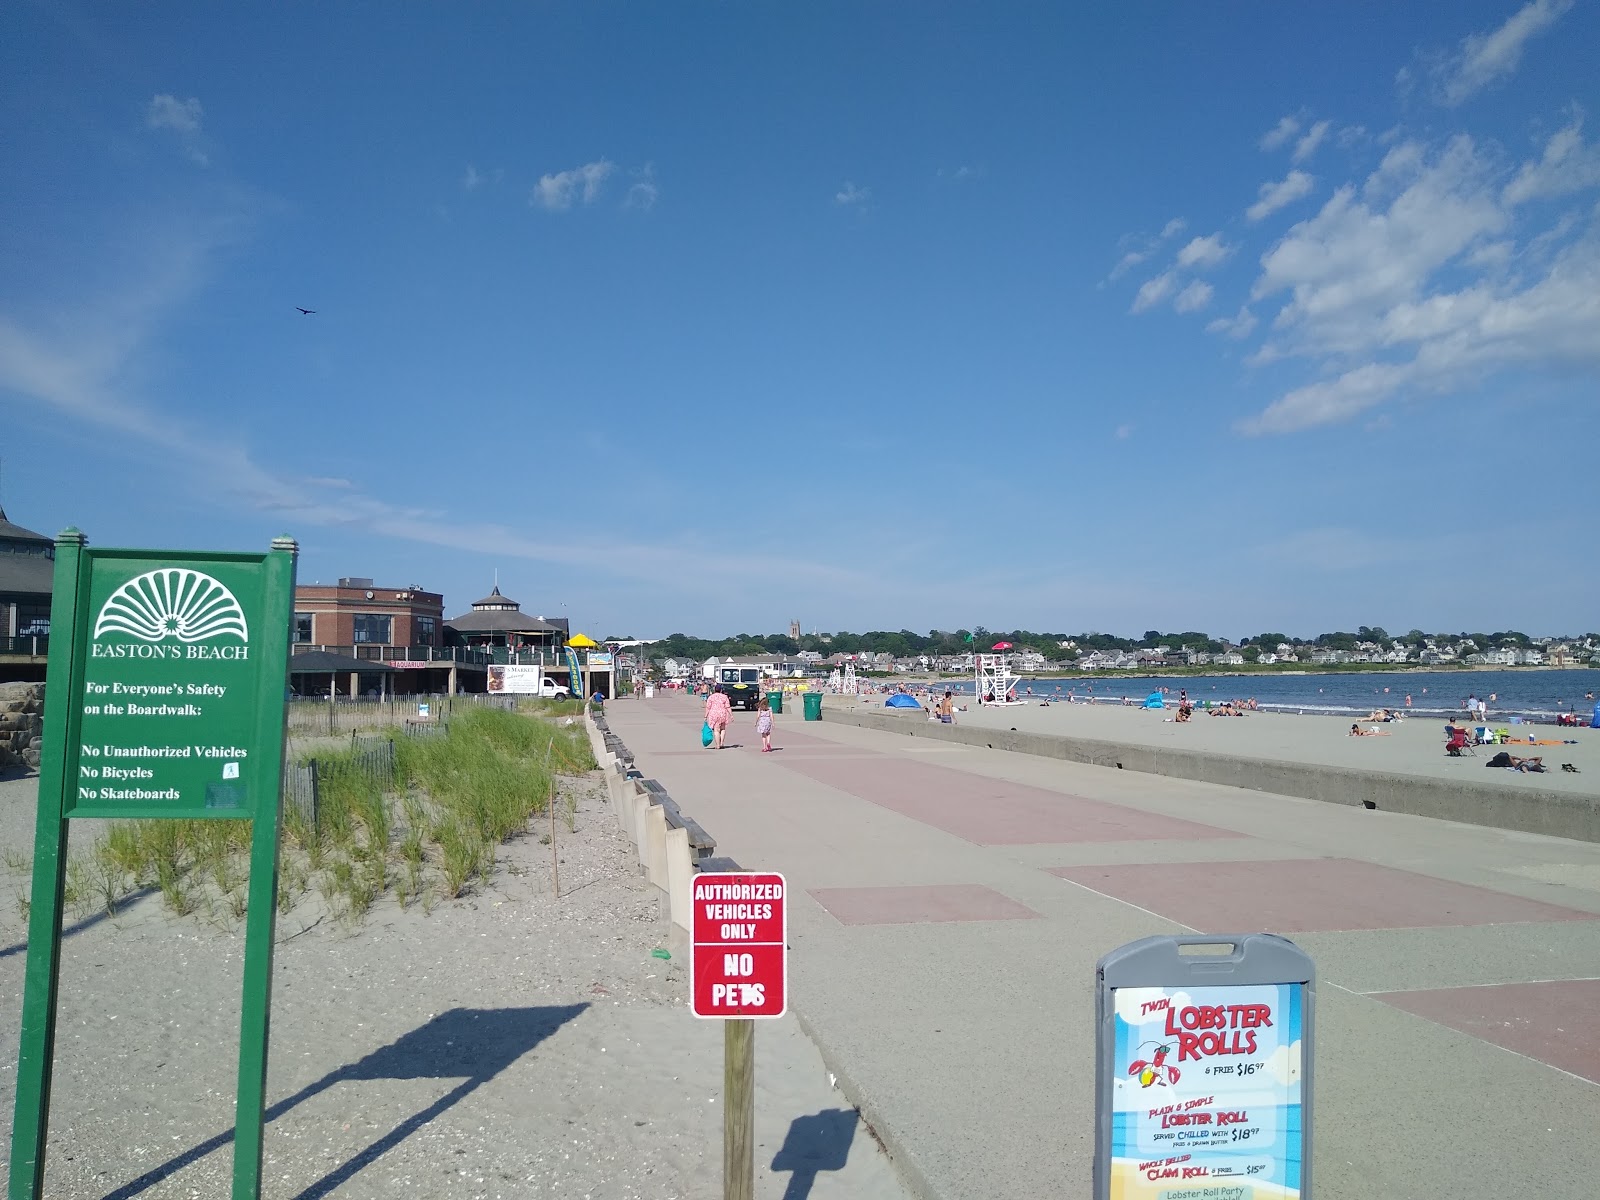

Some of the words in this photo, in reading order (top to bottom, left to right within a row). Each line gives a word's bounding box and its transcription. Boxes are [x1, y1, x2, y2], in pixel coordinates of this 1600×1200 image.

[92, 643, 182, 658] EASTON'S
[186, 645, 249, 659] BEACH
[86, 682, 110, 694] For
[113, 682, 183, 696] Everyone's
[187, 683, 226, 697] Safety
[84, 705, 100, 715] on
[104, 704, 124, 715] the
[127, 704, 202, 716] Boardwalk:
[81, 745, 100, 757] No
[104, 746, 190, 757] Unauthorized
[195, 746, 248, 758] Vehicles
[80, 766, 98, 778] No
[102, 767, 153, 780] Bicycles
[78, 788, 97, 799] No
[100, 788, 180, 799] Skateboards
[695, 884, 783, 900] AUTHORIZED
[705, 904, 772, 920] VEHICLES
[721, 923, 756, 939] ONLY
[724, 953, 754, 976] NO
[712, 983, 766, 1006] PETS
[1140, 998, 1171, 1016] TWIN
[1165, 1003, 1273, 1036] LOBSTER
[1178, 1029, 1257, 1062] ROLLS
[1213, 1066, 1234, 1075] FRIES
[1148, 1104, 1174, 1119] PLAIN
[1176, 1103, 1182, 1111] &
[1184, 1096, 1214, 1111] SIMPLE
[1161, 1113, 1213, 1129] LOBSTER
[1216, 1111, 1248, 1126] ROLL
[1153, 1133, 1175, 1141] SERVED
[1177, 1130, 1209, 1140] CHILLED
[1139, 1159, 1164, 1171] WHOLE
[1165, 1154, 1191, 1167] BELLIED
[1147, 1167, 1179, 1181] CLAM
[1182, 1166, 1209, 1179] ROLL
[1167, 1190, 1200, 1199] Lobster
[1203, 1187, 1219, 1197] Roll
[1221, 1186, 1244, 1197] Party
